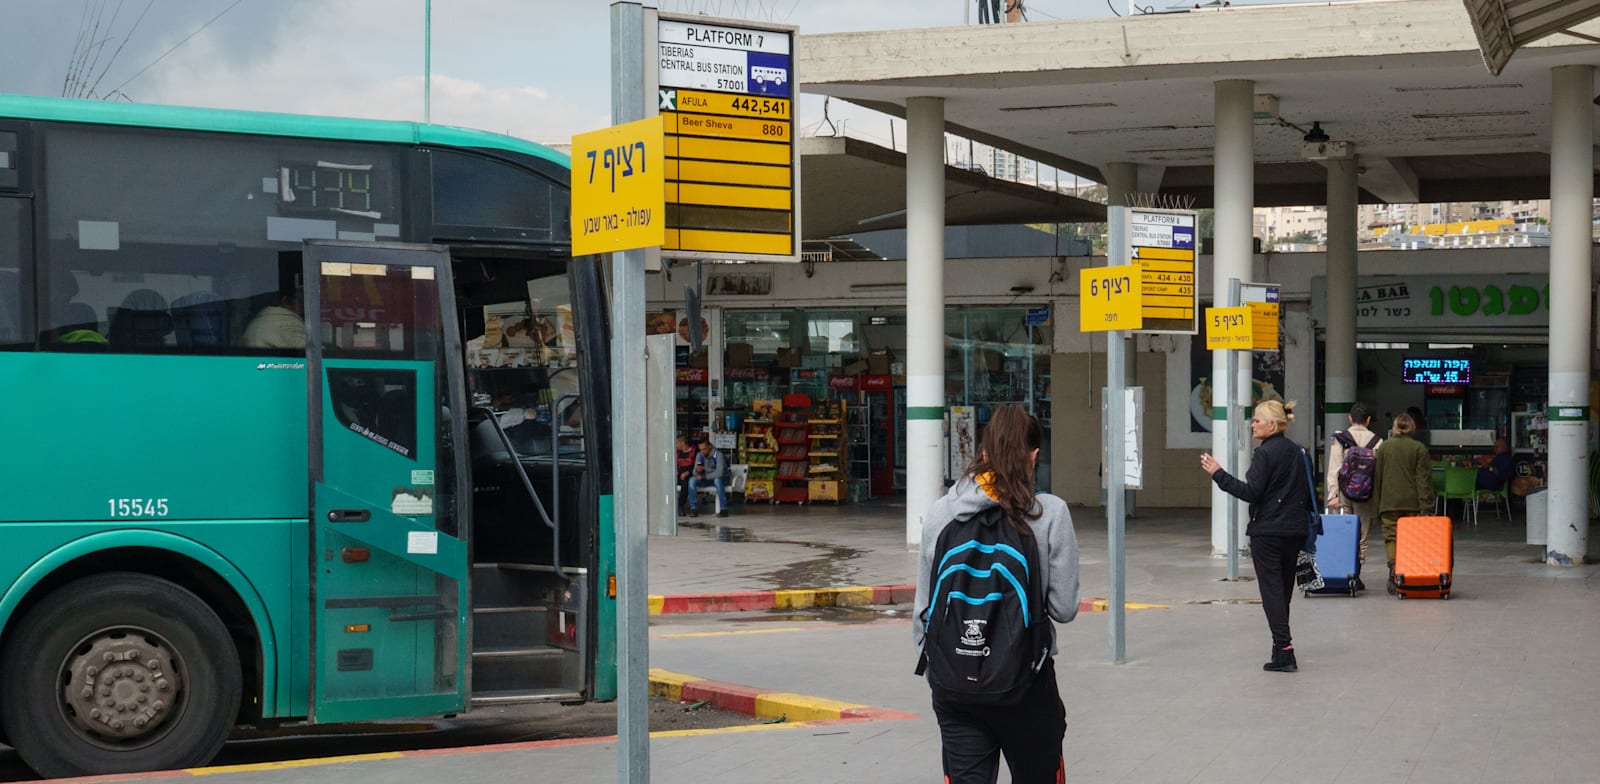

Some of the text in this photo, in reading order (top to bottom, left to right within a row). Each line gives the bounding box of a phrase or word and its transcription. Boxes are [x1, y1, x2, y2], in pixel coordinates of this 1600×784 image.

[687, 27, 764, 48] PLATFORM 7
[660, 45, 694, 58] TIBERIAS
[660, 58, 743, 76] CENTRAL BUS STATION
[717, 79, 744, 91] 57001
[682, 97, 785, 115] AFULA 442,541
[682, 117, 783, 136] Beer Sheva 880
[586, 141, 646, 193] רציף 7
[583, 215, 601, 236] שבע
[603, 213, 619, 231] באר
[626, 206, 652, 227] עפולה
[1143, 215, 1175, 224] PLATFORM
[1090, 276, 1130, 301] רציף 6
[1377, 286, 1409, 299] BAR
[1104, 313, 1118, 322] חיפה
[1357, 306, 1411, 317] כשר למ
[1214, 314, 1244, 331] רציף 5
[1404, 359, 1469, 371] קפה ומאפה
[1415, 371, 1458, 382] 15 ש"ח
[108, 499, 169, 517] 15545
